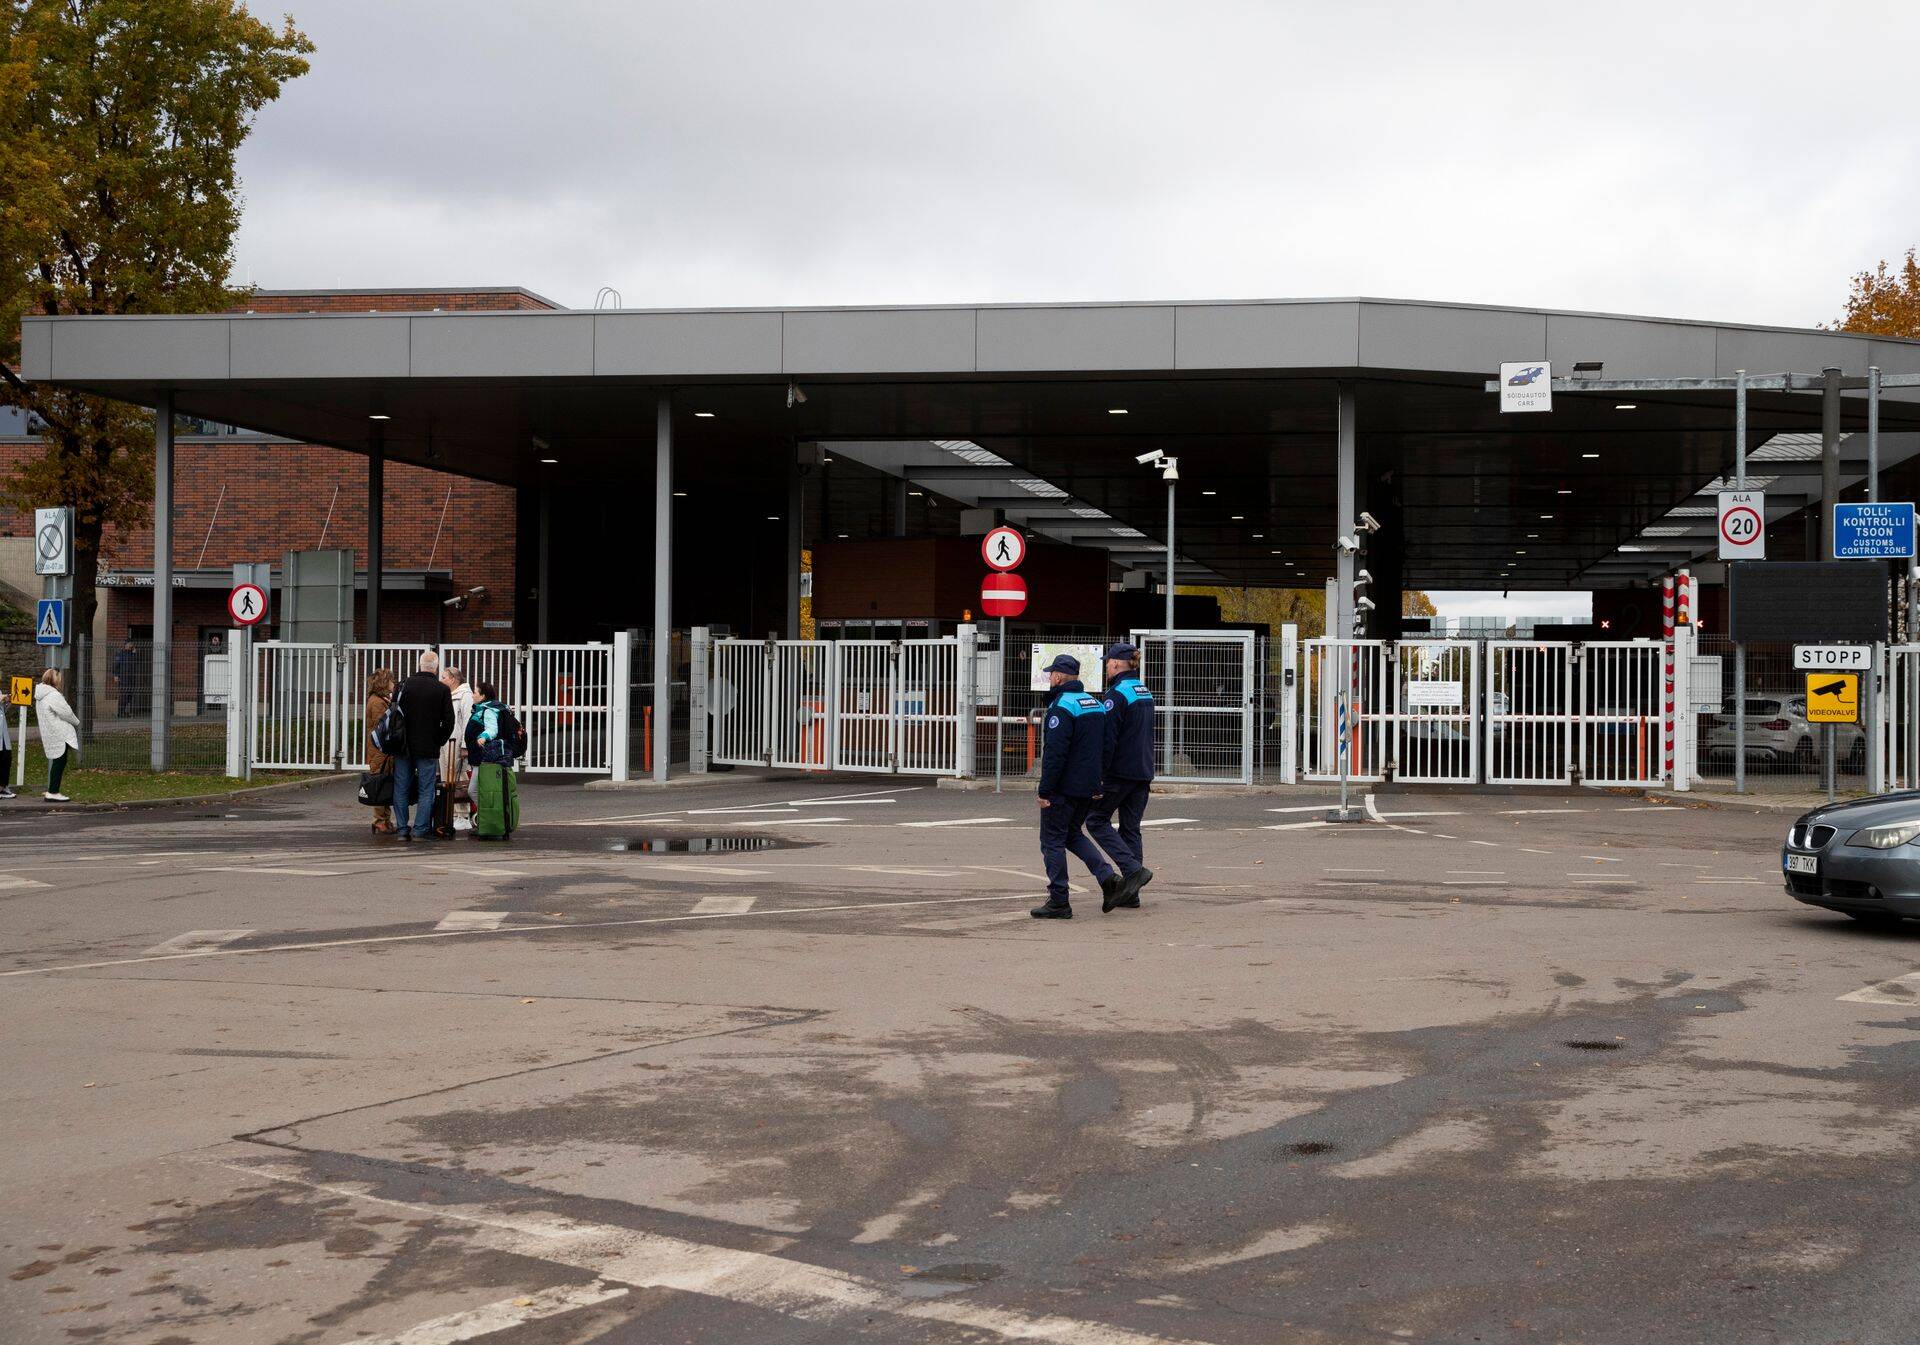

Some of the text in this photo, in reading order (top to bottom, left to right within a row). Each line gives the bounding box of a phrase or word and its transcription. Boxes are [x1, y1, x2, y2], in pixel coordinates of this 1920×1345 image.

[1732, 494, 1751, 502] ALA
[1857, 507, 1892, 516] TOLLI-
[1732, 518, 1753, 535] 20
[1843, 518, 1905, 527] KONTROLLI
[1856, 528, 1893, 537] TSOON
[1853, 539, 1894, 547] CUSTOMS
[1884, 546, 1906, 554] ZONE
[1802, 650, 1861, 664] STOPP
